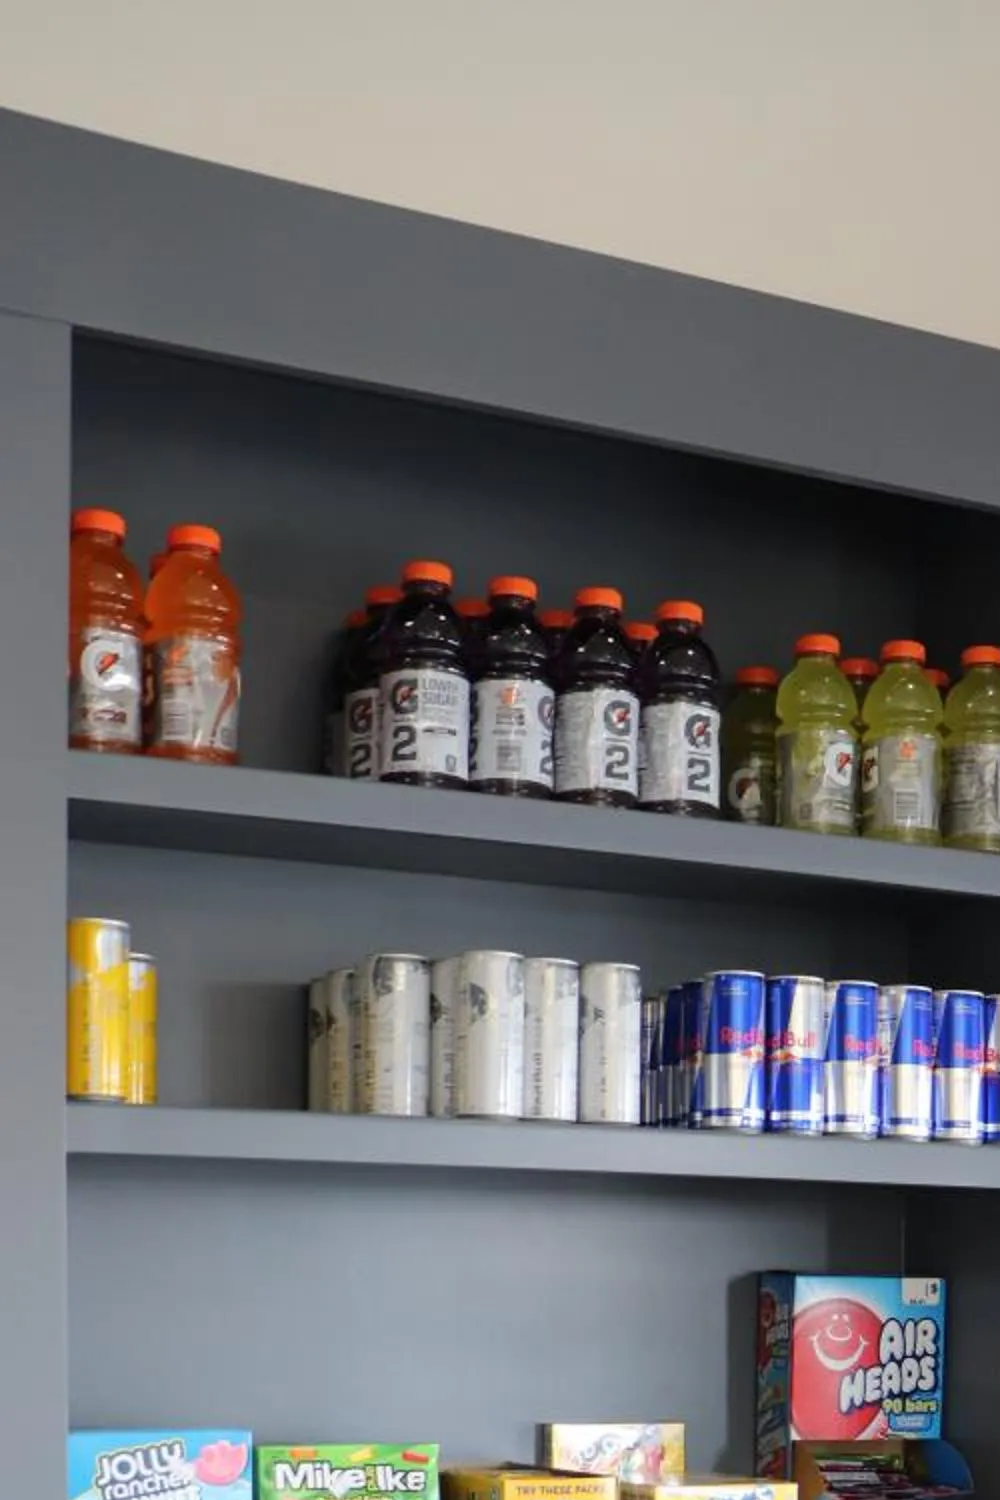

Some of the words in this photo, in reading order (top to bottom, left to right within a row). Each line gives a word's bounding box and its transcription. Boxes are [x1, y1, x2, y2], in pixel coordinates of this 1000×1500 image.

[391, 724, 416, 761] 2
[605, 745, 630, 781] 2
[687, 757, 711, 793] 2
[879, 1319, 937, 1365] AIR
[840, 1355, 936, 1414] HEADS
[882, 1397, 903, 1414] 90
[905, 1397, 937, 1414] bars
[97, 1442, 182, 1485] JOLLY
[274, 1460, 366, 1492] Mike
[376, 1464, 426, 1491] Ike
